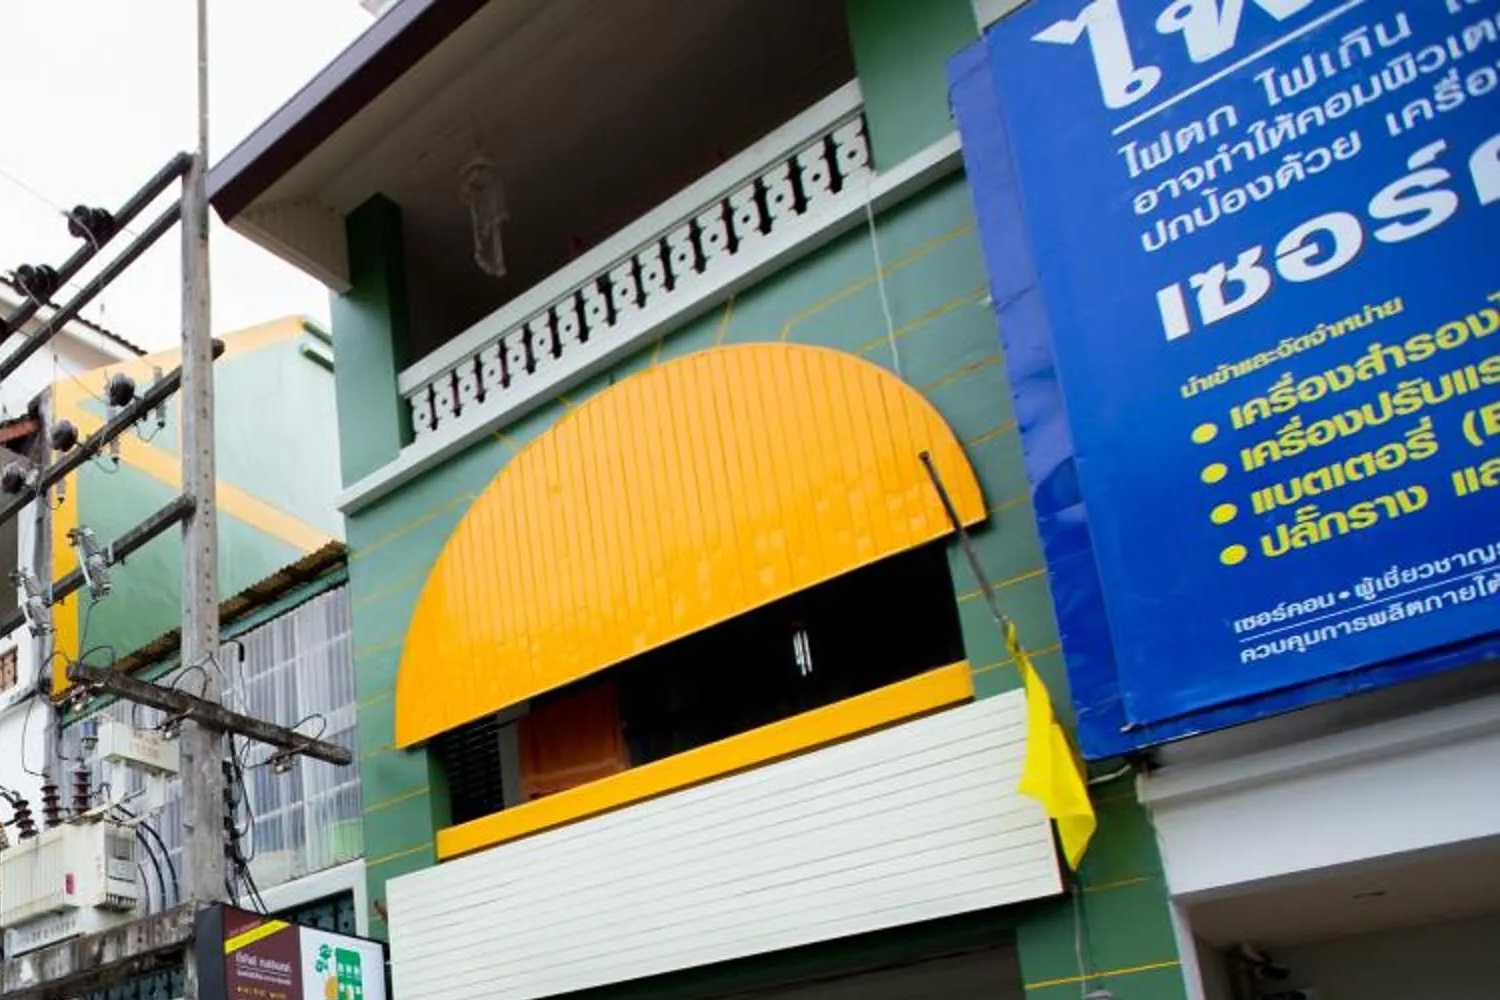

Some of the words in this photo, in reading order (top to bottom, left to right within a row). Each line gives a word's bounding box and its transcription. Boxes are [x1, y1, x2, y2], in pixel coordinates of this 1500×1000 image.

[1117, 104, 1238, 179] ไฟตก
[1254, 12, 1413, 107] ไฟเกิน
[1132, 10, 1500, 216] อาจทำให้คอมพิวเต
[1141, 130, 1362, 253] ปกป้องด้วย
[1385, 60, 1500, 137] เครื่อ
[1251, 415, 1439, 514] แบตเตอรี่
[1261, 484, 1429, 558] ปลั๊กราง
[1353, 541, 1500, 601] ผู้เชี่ยวชาญ
